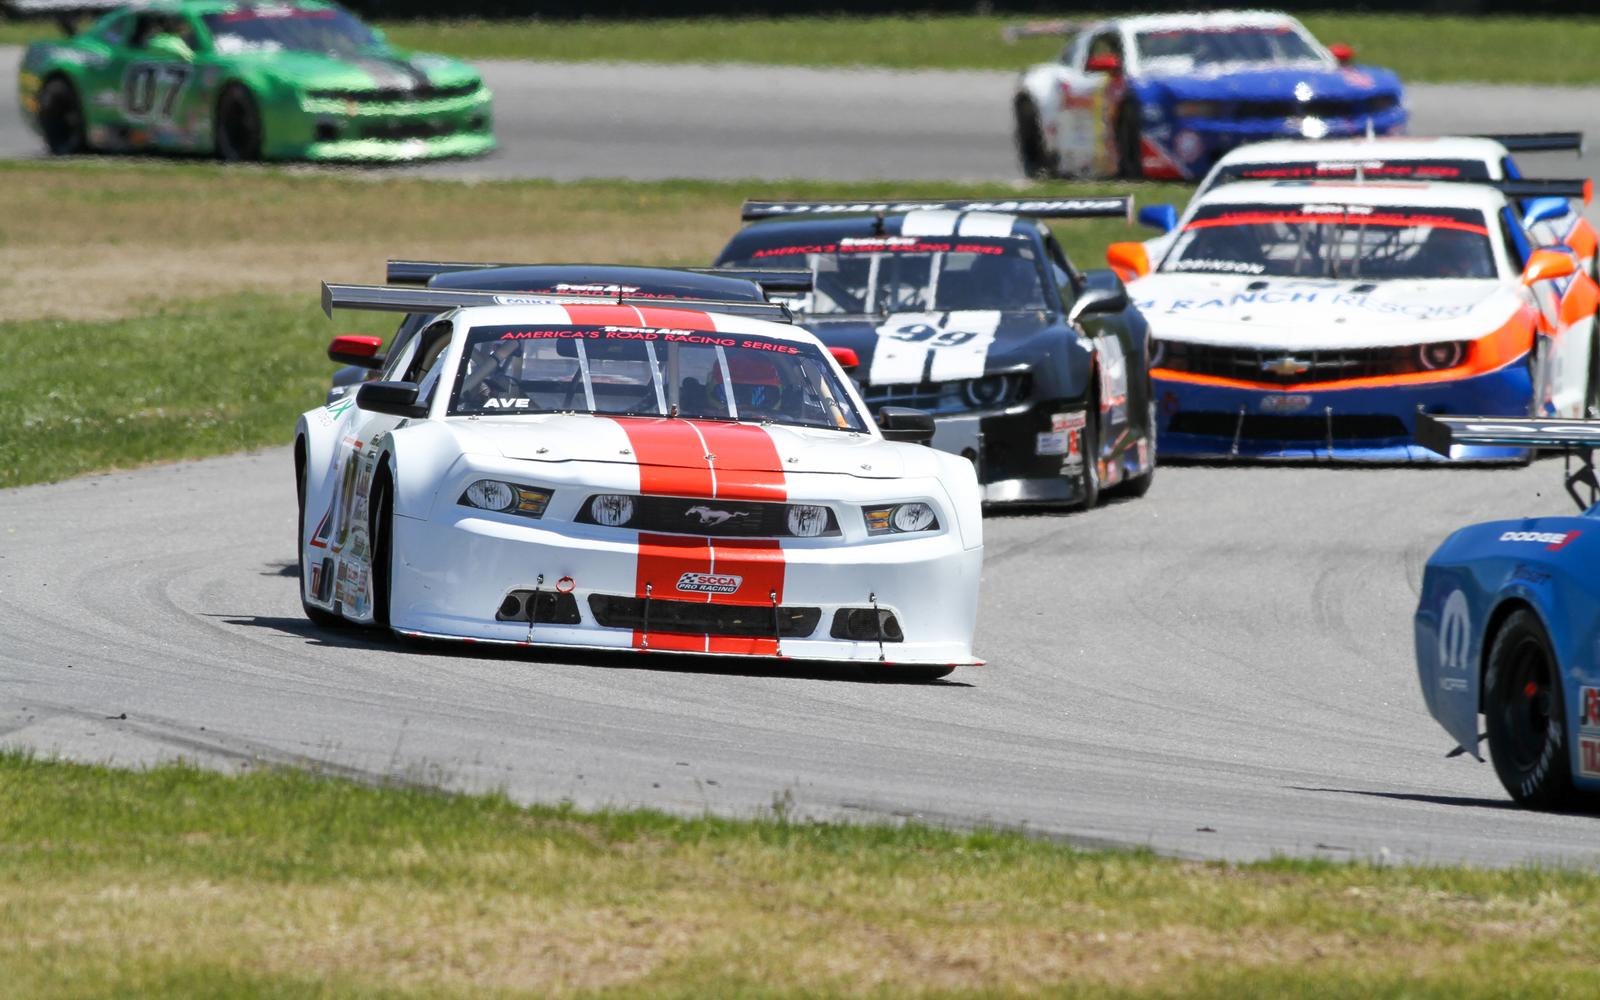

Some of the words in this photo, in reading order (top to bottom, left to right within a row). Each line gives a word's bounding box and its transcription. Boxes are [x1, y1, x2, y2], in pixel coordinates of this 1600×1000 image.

[889, 324, 978, 347] 99
[501, 331, 600, 339] AMERICA'S
[606, 332, 658, 340] ROAD
[664, 334, 736, 346] RACING
[741, 341, 799, 354] SERIES
[483, 398, 530, 408] AVE
[1499, 531, 1568, 544] DODGE
[698, 576, 736, 586] SCCA
